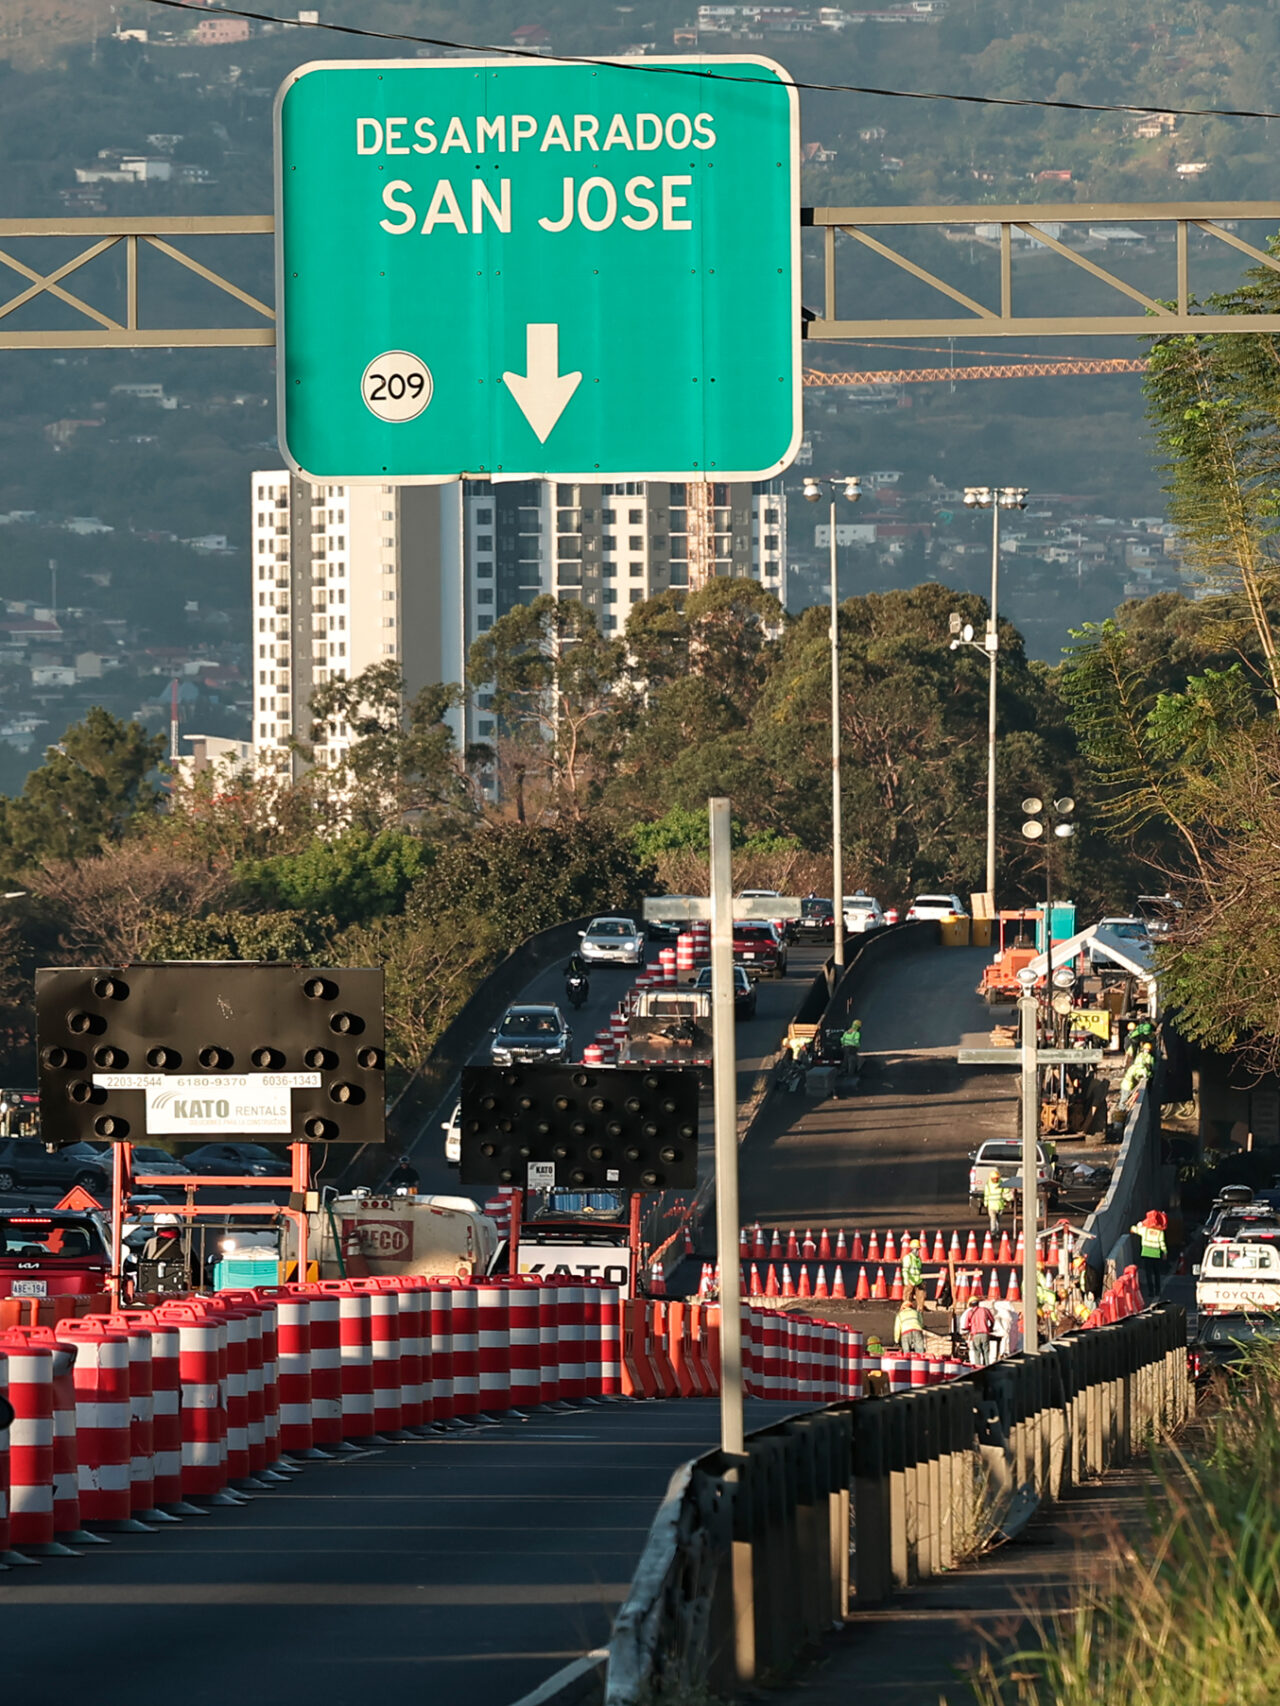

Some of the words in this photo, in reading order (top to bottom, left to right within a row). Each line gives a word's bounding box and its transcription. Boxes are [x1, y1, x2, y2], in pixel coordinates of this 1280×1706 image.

[356, 112, 717, 155] DESAMPARADOS
[379, 178, 511, 234] SAN
[538, 175, 692, 232] JOSE
[369, 373, 425, 401] 209
[107, 1076, 162, 1087] 2203-2544
[177, 1078, 247, 1087] 6180-9370
[262, 1075, 318, 1086] 6036-1343
[174, 1099, 230, 1119] KATO
[235, 1106, 287, 1116] RENTALS
[536, 1166, 553, 1174] KATO
[1215, 1291, 1265, 1300] TOYOTA
